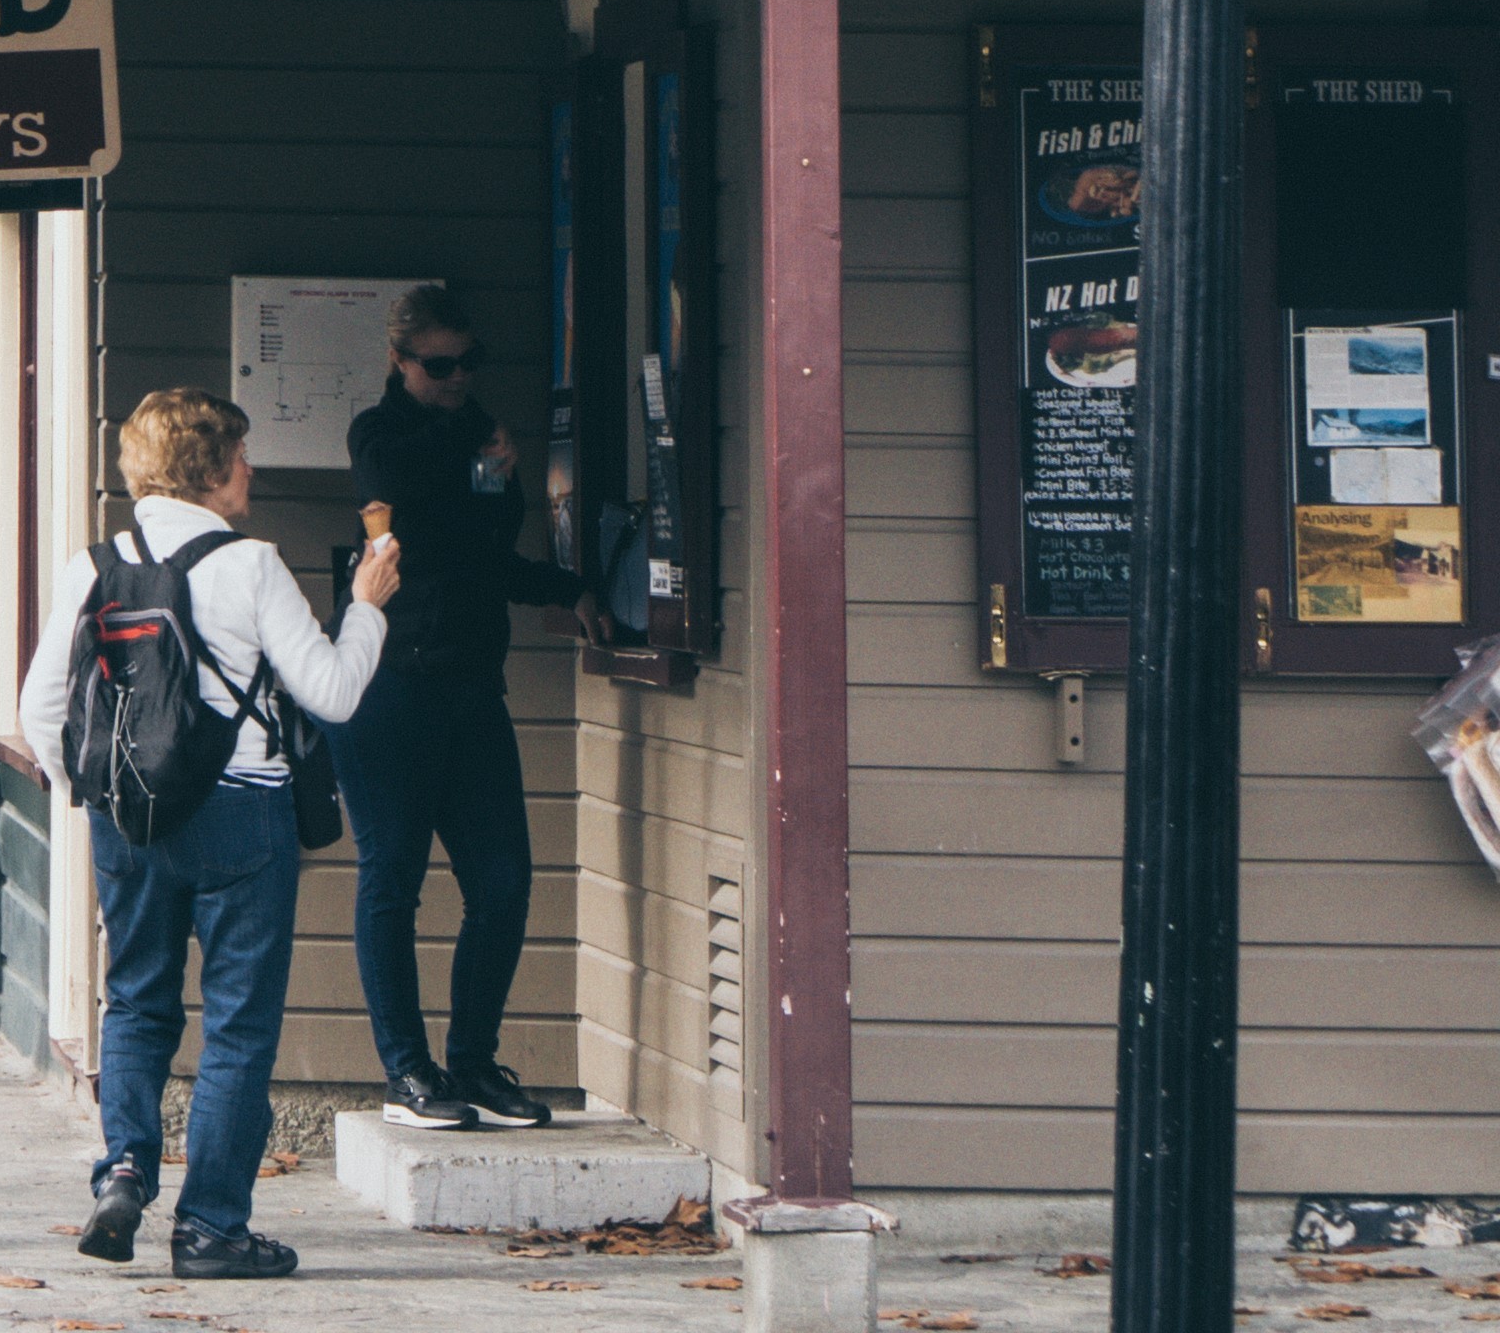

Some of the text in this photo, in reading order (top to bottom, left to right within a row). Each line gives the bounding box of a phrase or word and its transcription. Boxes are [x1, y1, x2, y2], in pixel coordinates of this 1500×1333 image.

[1049, 78, 1142, 103] THE SHE
[1312, 80, 1424, 104] THE SHED
[1038, 127, 1082, 157] Fish
[1087, 123, 1104, 149] &
[1107, 118, 1142, 148] Chi
[1045, 275, 1140, 313] NZ Hot D
[1036, 441, 1073, 452] Chicken
[1038, 454, 1061, 465] Mini
[1063, 453, 1099, 467] Spring
[1102, 453, 1123, 464] Roll
[1086, 466, 1108, 478] Fish
[1039, 480, 1064, 491] Mini
[1301, 512, 1373, 529] Analysing
[1040, 537, 1078, 550] Milk
[1038, 551, 1066, 564] Hot
[1040, 565, 1069, 581] Hot
[1073, 565, 1113, 582] Drink
